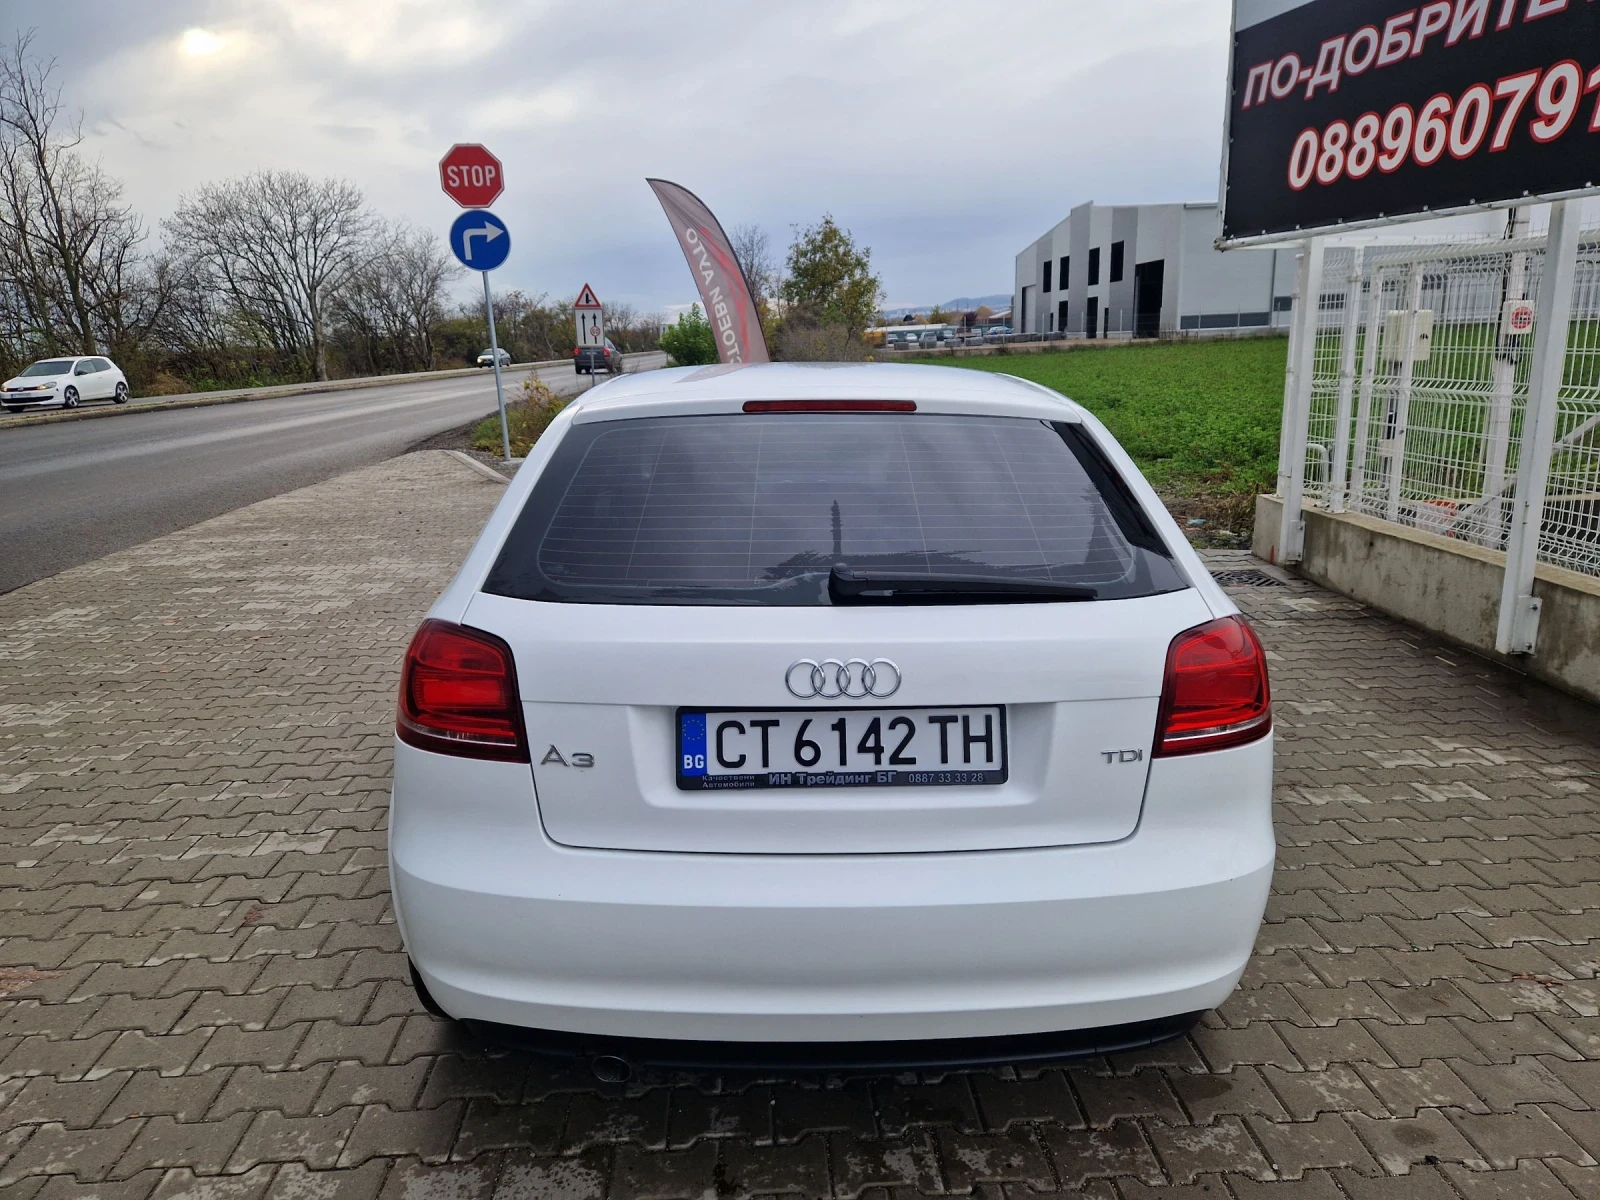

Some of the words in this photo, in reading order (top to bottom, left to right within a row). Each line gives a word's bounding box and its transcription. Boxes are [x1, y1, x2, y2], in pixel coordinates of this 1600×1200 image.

[447, 165, 496, 187] STOP
[716, 720, 780, 768] CT
[794, 716, 917, 767] 6142
[928, 714, 994, 764] TH
[541, 744, 594, 768] A3
[683, 754, 705, 769] BG
[1100, 748, 1143, 764] TDI
[768, 773, 792, 785] ИН
[796, 772, 872, 786] Трейдинг
[876, 771, 897, 783] БГ
[908, 773, 934, 783] 0887
[938, 773, 951, 782] 33
[955, 773, 968, 782] 33
[971, 772, 984, 782] 28
